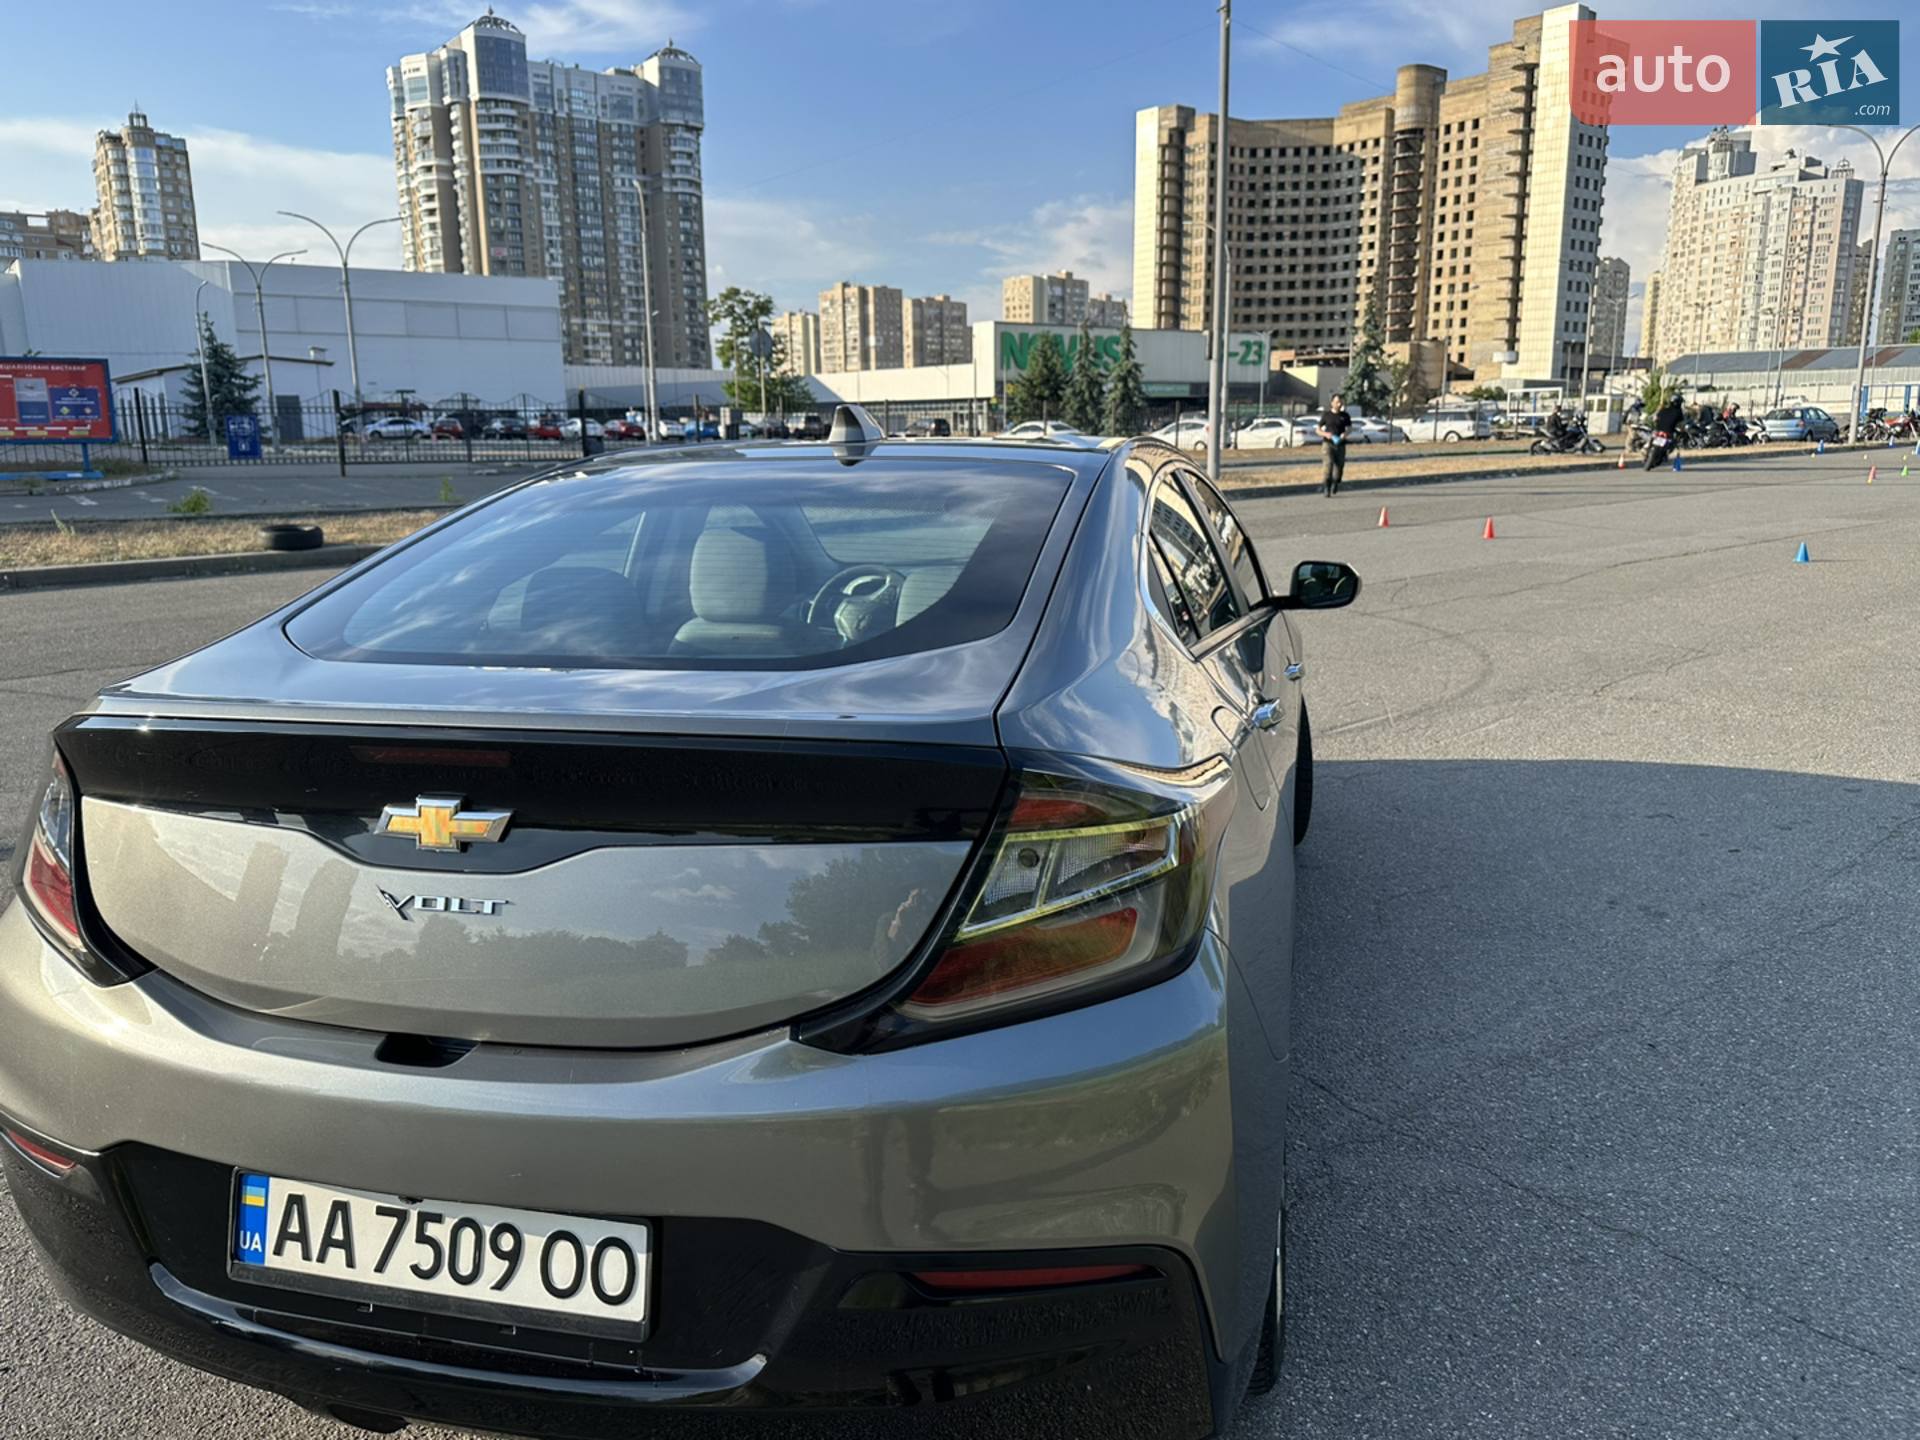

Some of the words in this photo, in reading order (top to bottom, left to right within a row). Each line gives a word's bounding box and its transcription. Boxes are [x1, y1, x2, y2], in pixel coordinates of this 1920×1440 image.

[1000, 331, 1121, 371] NVS
[1219, 340, 1265, 366] -23
[376, 884, 509, 921] VOLT
[240, 1230, 262, 1253] UA
[373, 1205, 523, 1291] 7509
